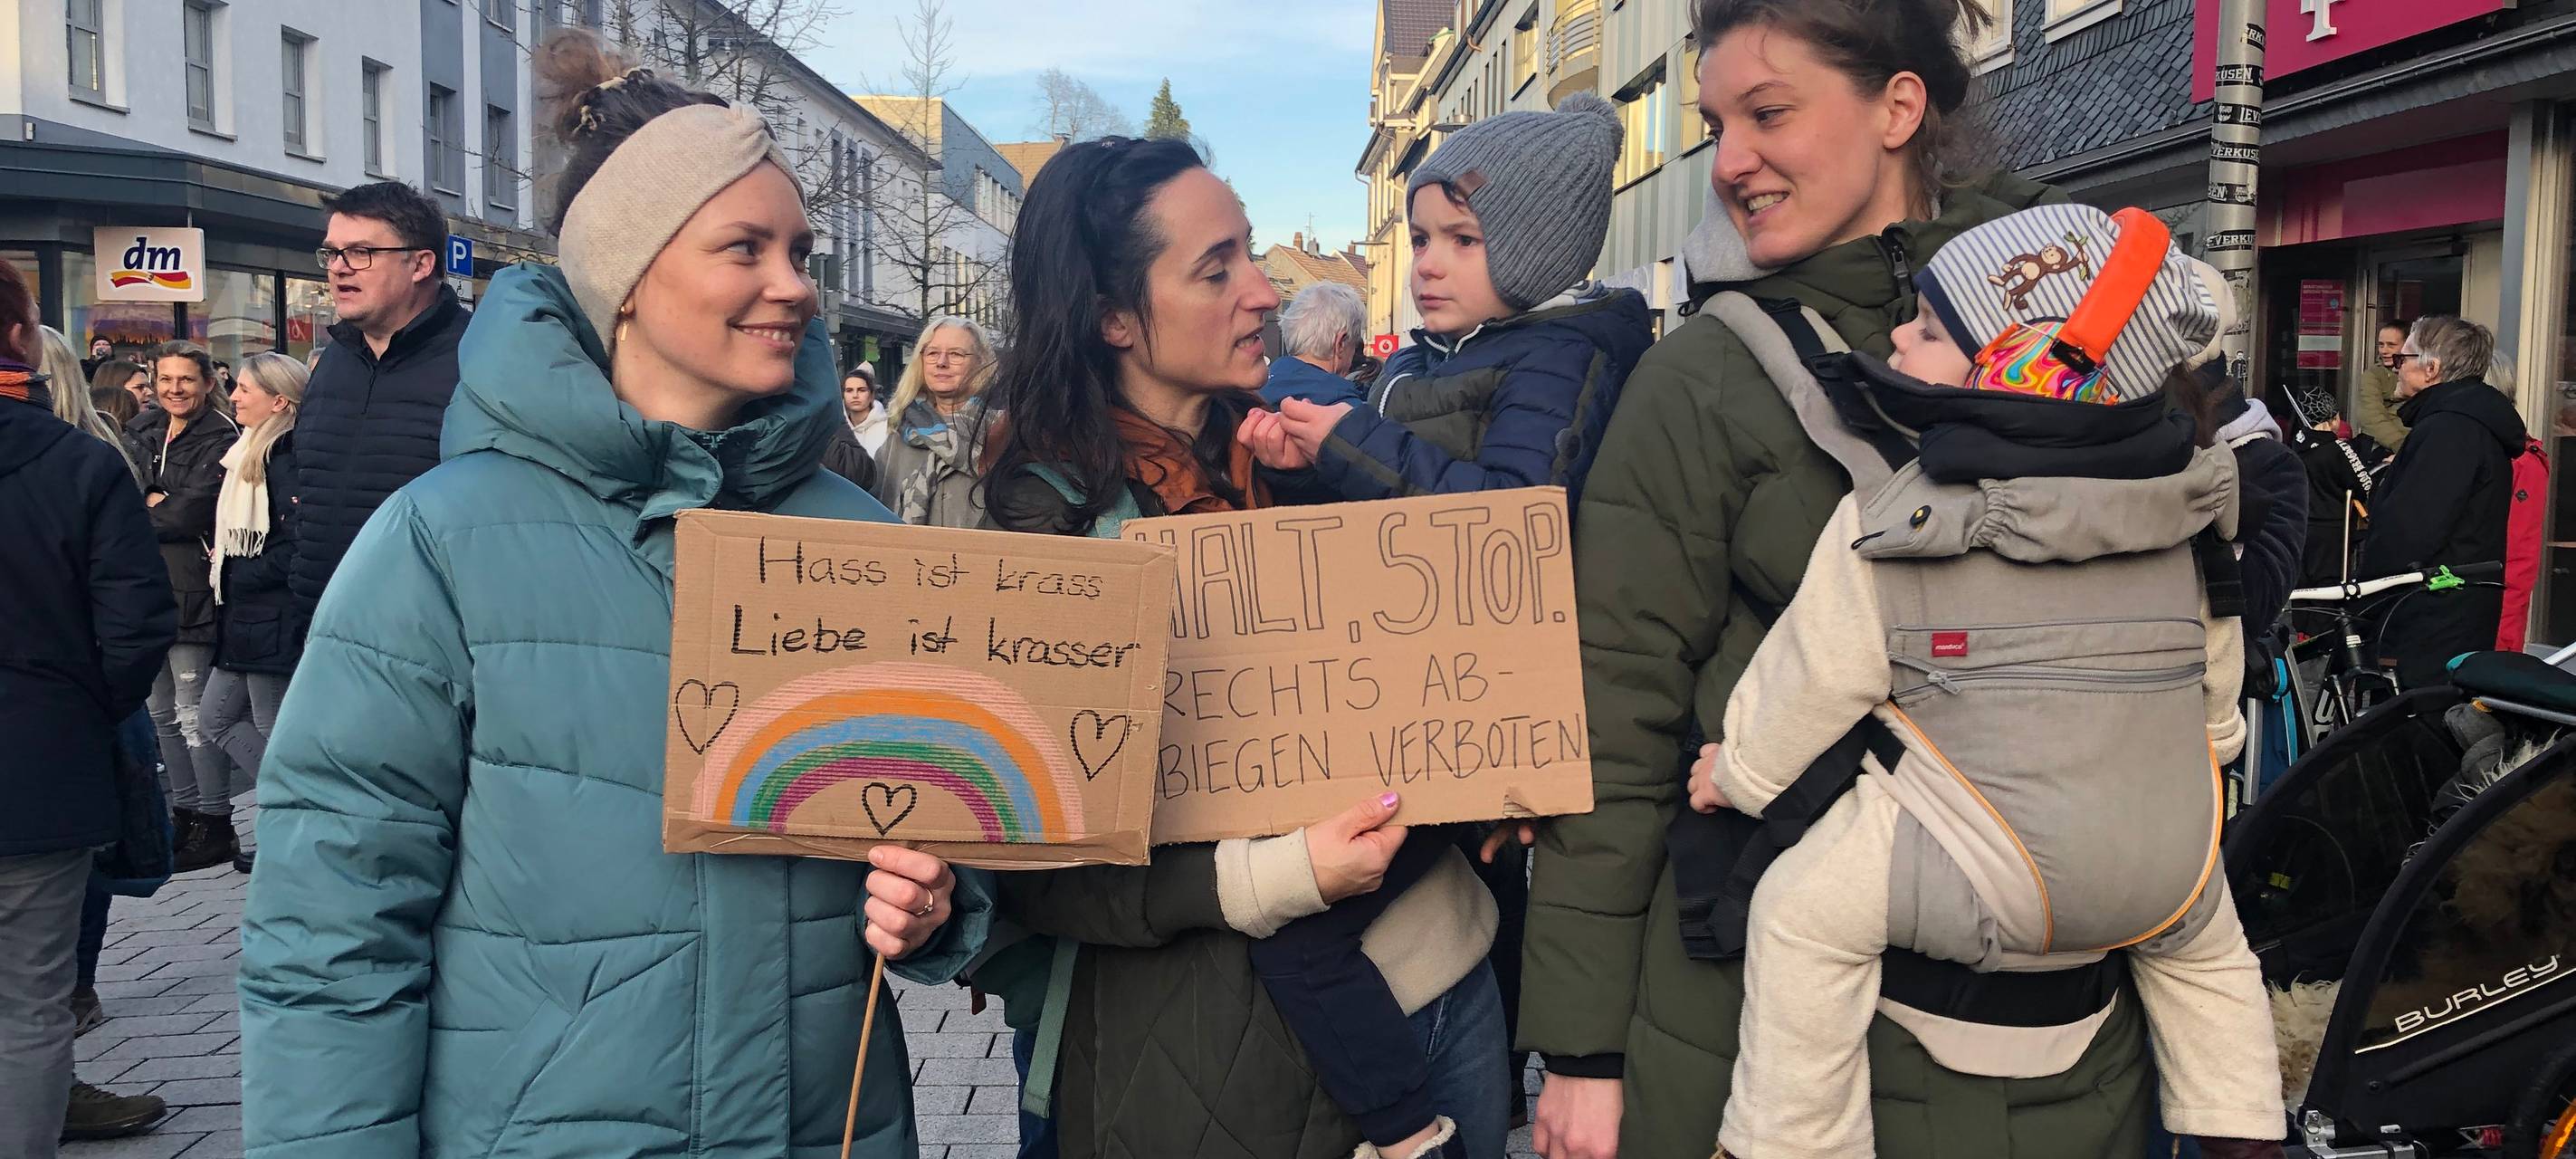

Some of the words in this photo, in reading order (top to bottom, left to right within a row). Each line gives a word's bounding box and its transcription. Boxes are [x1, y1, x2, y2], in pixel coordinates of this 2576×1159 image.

[124, 237, 181, 270] dm
[453, 241, 467, 269] P
[759, 536, 887, 586] Hass
[914, 553, 970, 588] ist
[997, 558, 1103, 599] krass
[1136, 516, 1360, 643] ALT,
[1373, 503, 1566, 635] STOP.
[731, 604, 868, 656] Liebe
[908, 616, 959, 656] ist
[987, 618, 1142, 669] krasser
[1164, 657, 1380, 720] RECHTS
[1422, 652, 1514, 707] AB-
[1159, 730, 1331, 800] BIEGEN
[1369, 713, 1582, 787] VERBOTEN
[2394, 955, 2559, 1033] BURLEY
